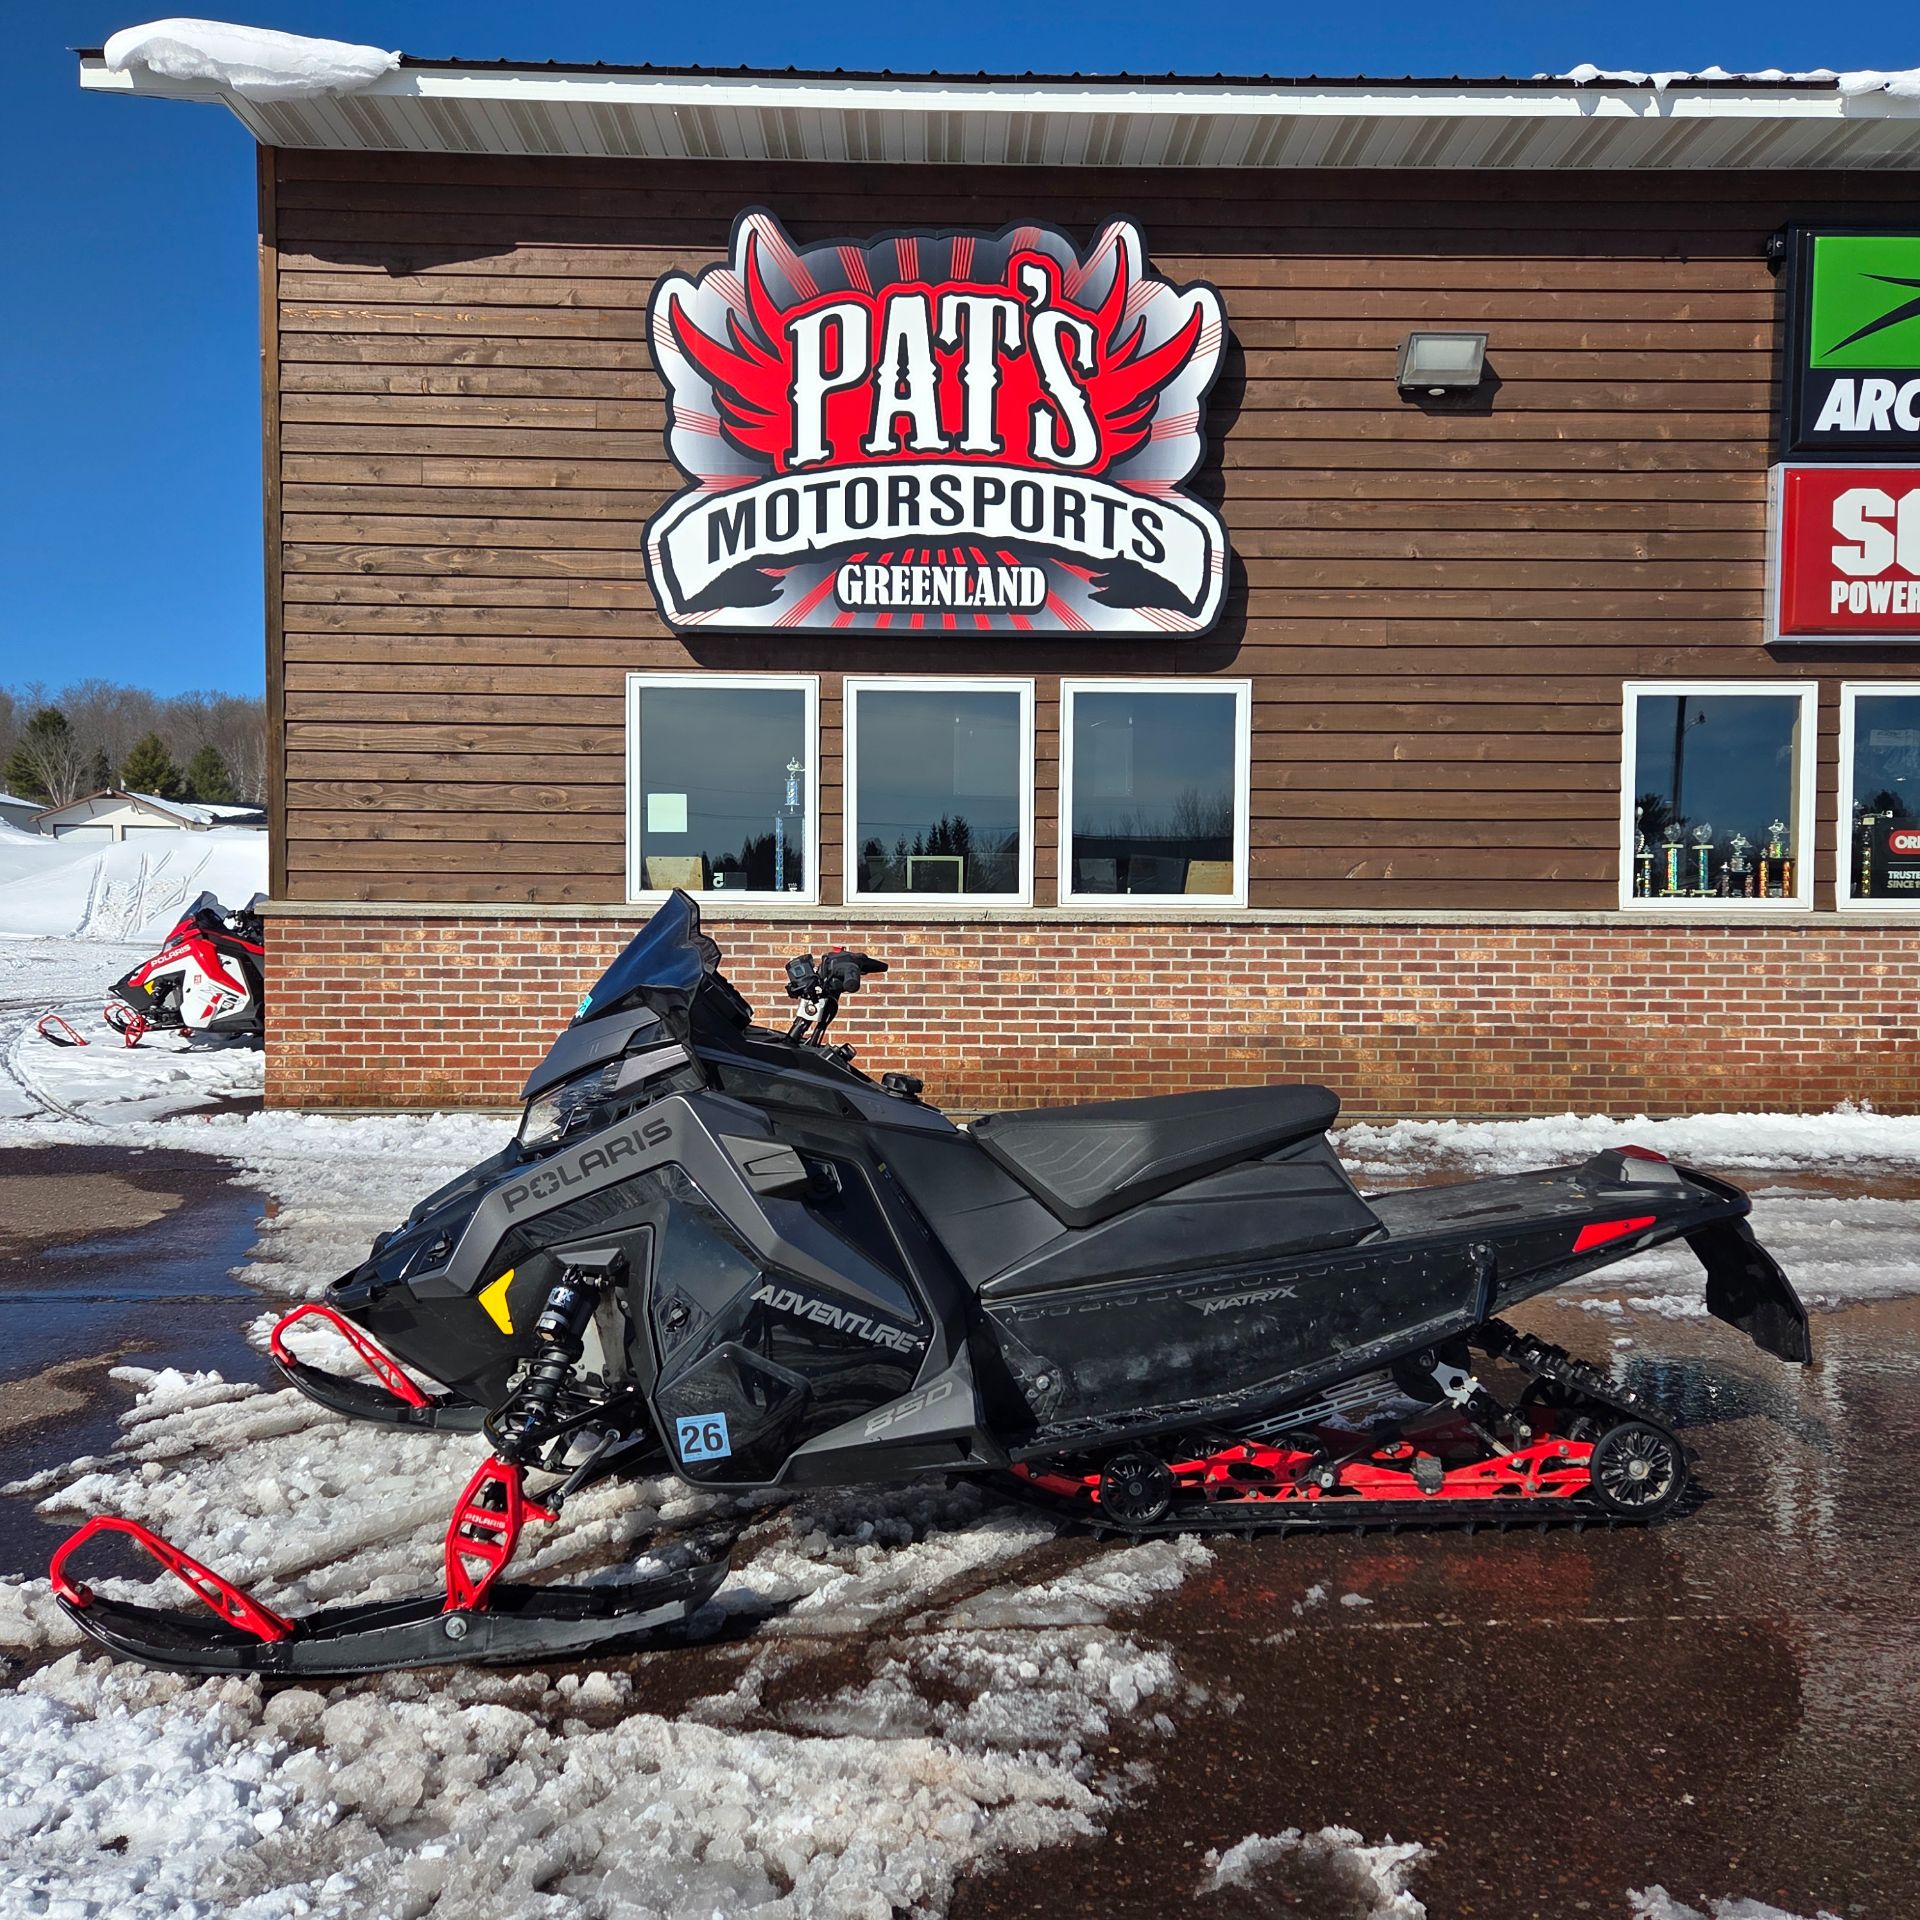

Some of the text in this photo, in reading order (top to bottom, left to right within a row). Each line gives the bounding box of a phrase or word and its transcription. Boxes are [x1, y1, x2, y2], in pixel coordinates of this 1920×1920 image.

[789, 265, 1097, 467] PAT'S
[1813, 378, 1920, 432] ARC
[707, 474, 1167, 565] MOTORSPORTS
[837, 564, 1046, 608] GREENLAND
[1830, 580, 1920, 614] POWER
[1887, 880, 1914, 889] SINCE
[150, 943, 192, 968] POLARIS
[501, 1117, 673, 1213] POLARIS
[750, 1284, 919, 1354] ADVENTURE
[1202, 1285, 1298, 1317] MATRYX
[864, 1382, 953, 1437] 850
[681, 1422, 724, 1454] 26
